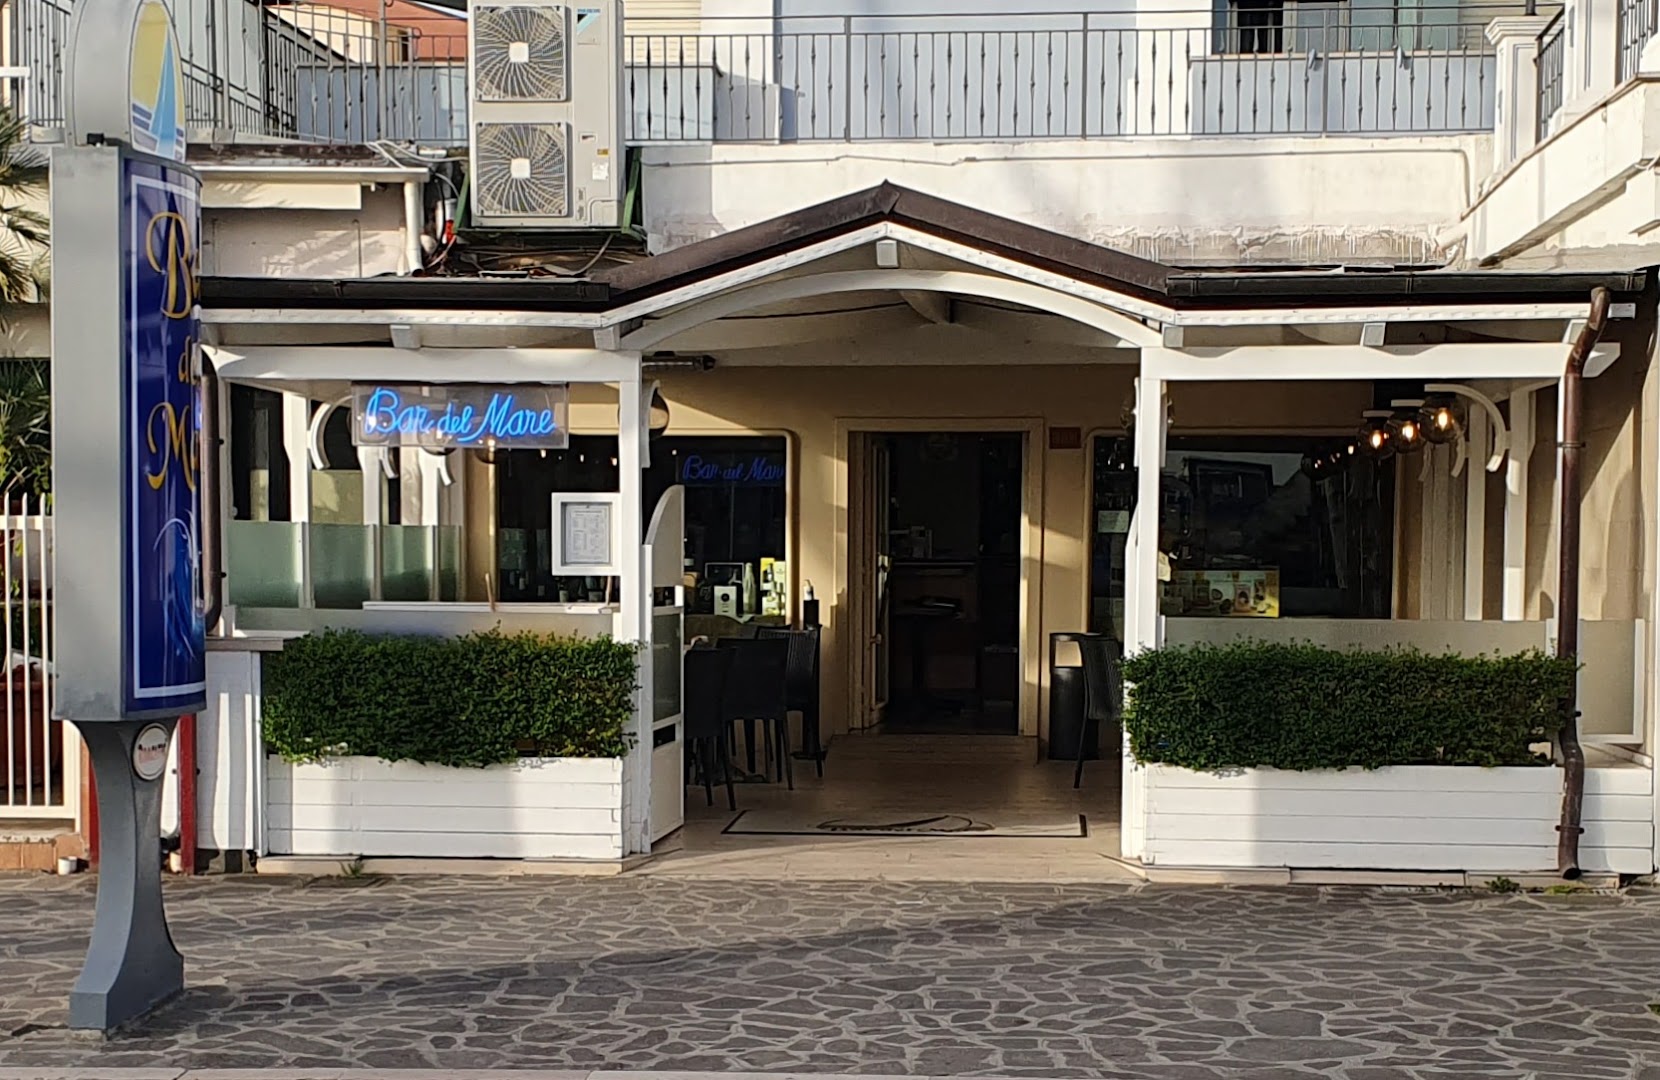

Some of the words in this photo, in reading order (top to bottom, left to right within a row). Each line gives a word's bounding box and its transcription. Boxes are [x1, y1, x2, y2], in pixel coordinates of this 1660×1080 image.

[364, 386, 434, 434] Bar
[437, 401, 471, 434] del
[457, 393, 556, 442] Mare
